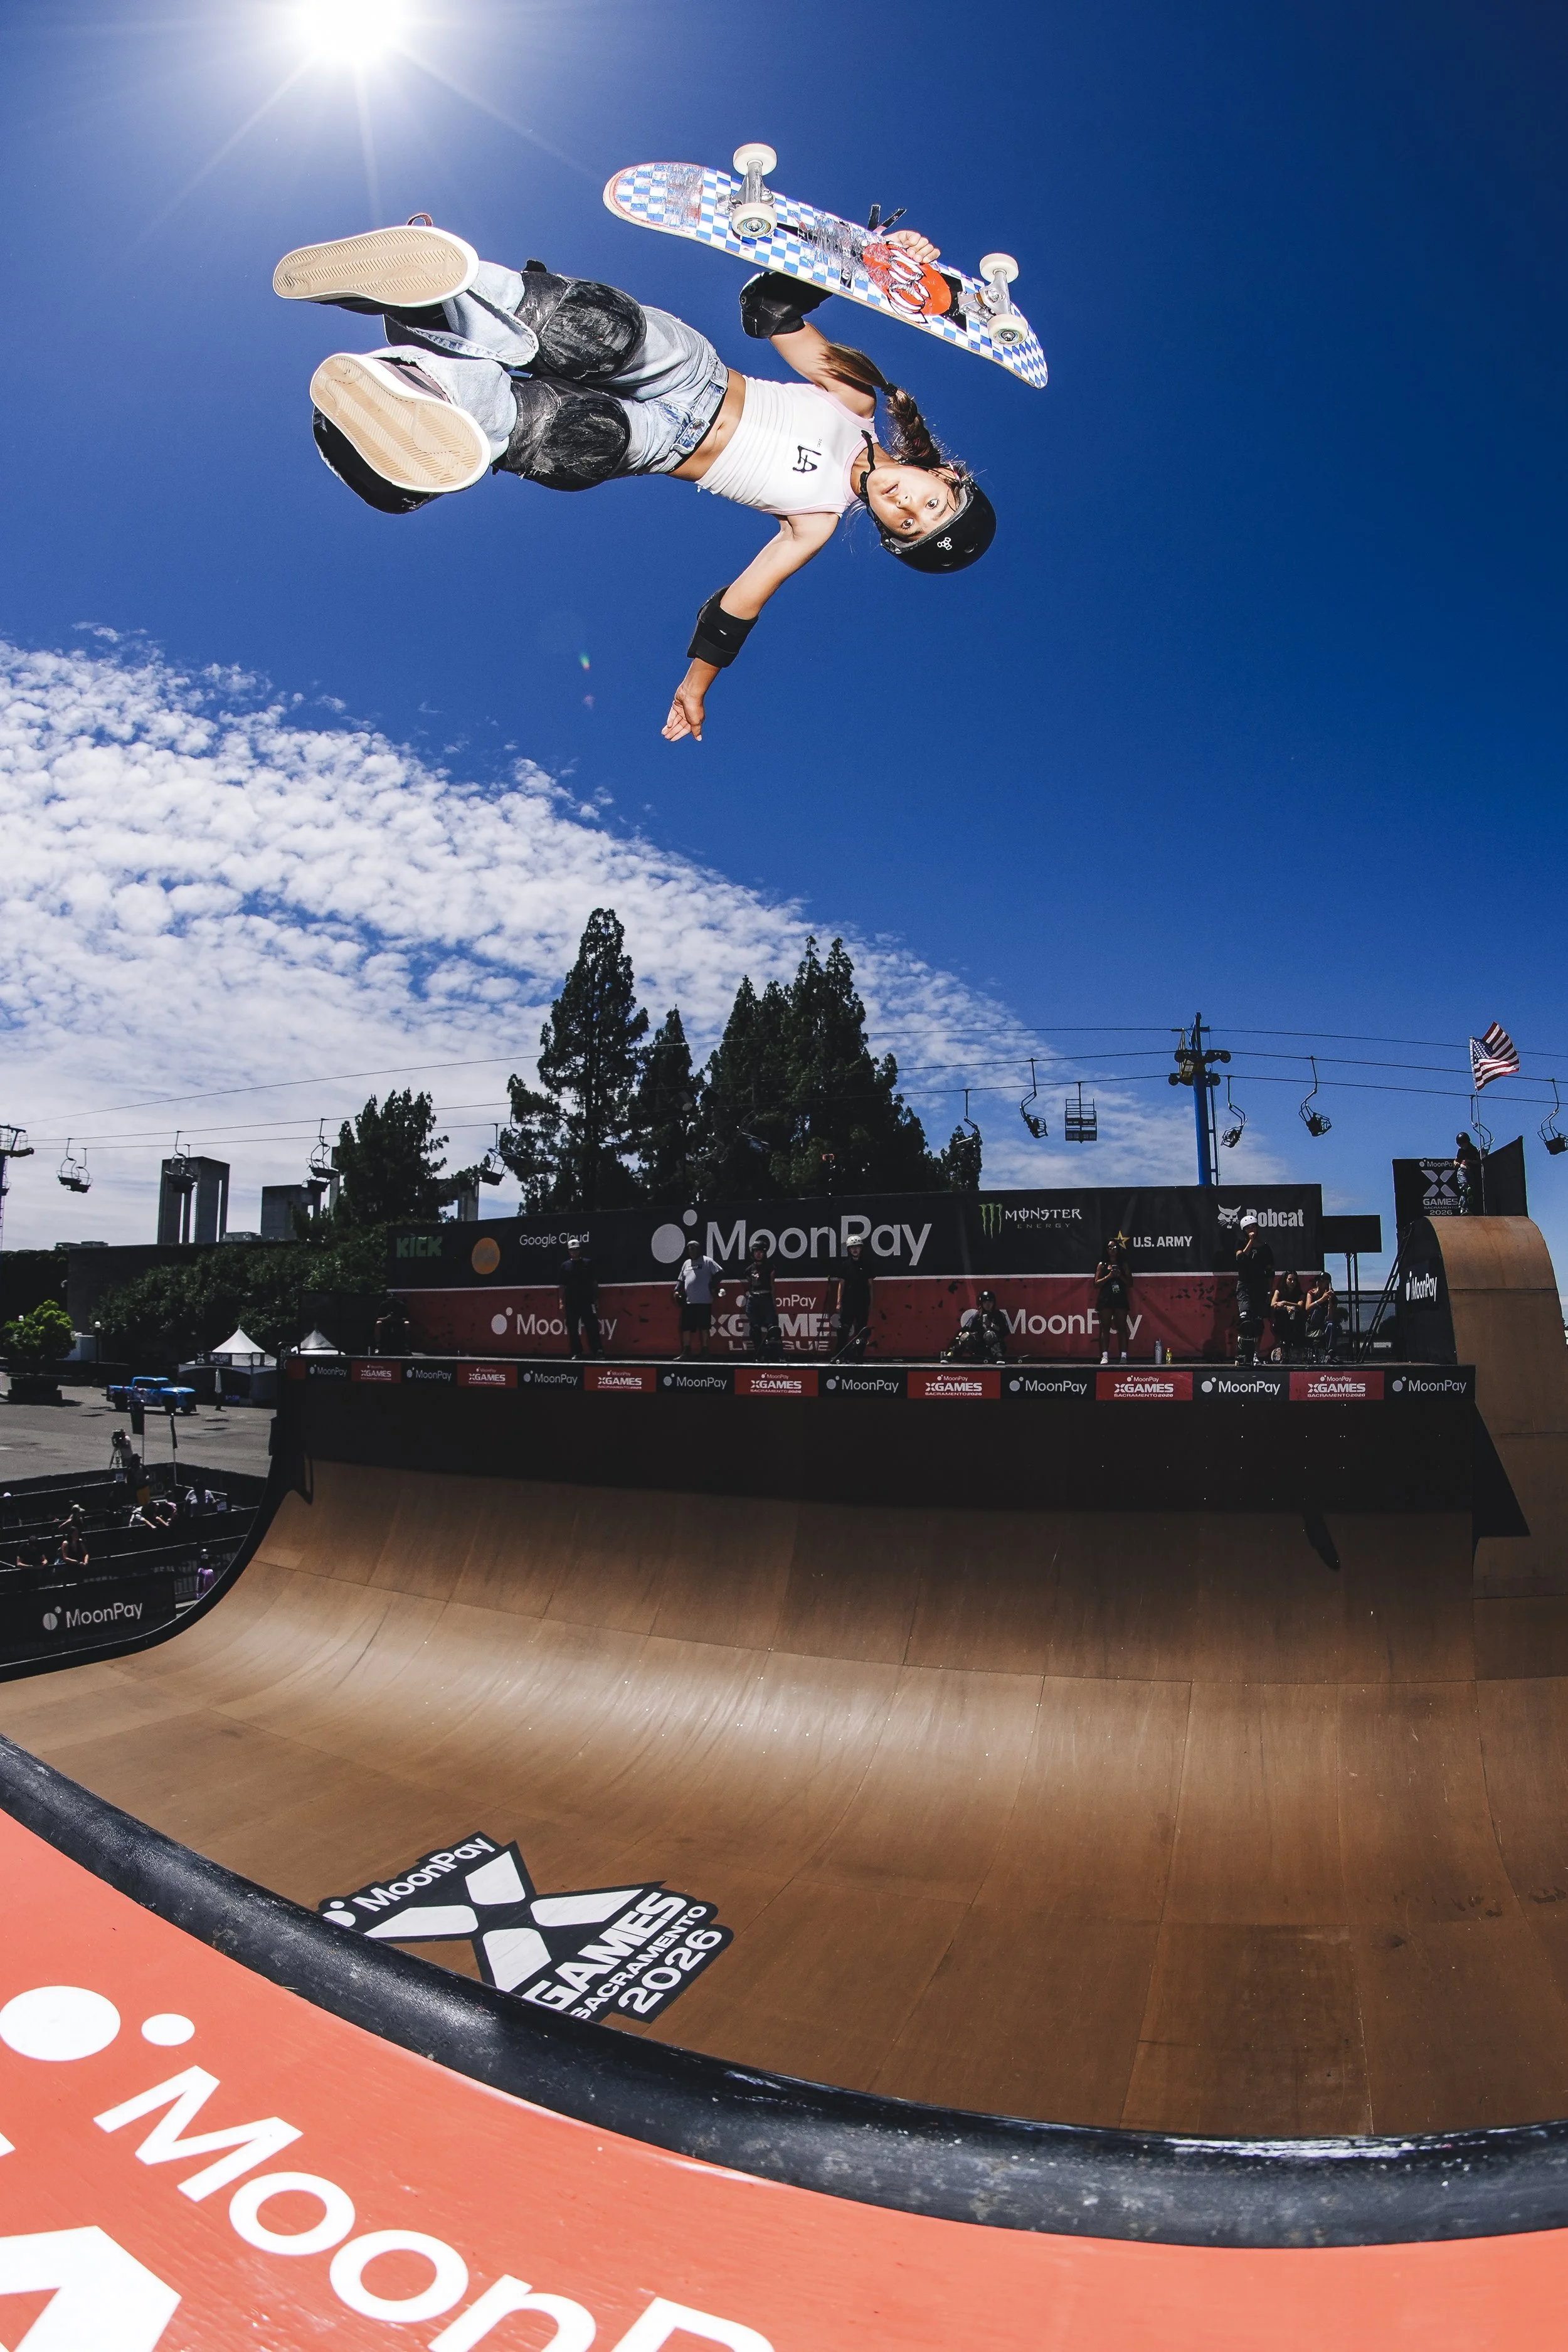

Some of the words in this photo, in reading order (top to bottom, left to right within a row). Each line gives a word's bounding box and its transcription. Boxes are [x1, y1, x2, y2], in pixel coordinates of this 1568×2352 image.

[1005, 1207, 1083, 1222] MONSTER
[396, 1236, 443, 1258] KICK
[519, 1233, 557, 1248] Google
[706, 1214, 933, 1266] MoonPay
[1133, 1236, 1155, 1248] U.S.
[1157, 1236, 1193, 1248] ARMY
[1411, 1273, 1438, 1302] MoonPay
[999, 1308, 1143, 1340] MoonPy
[728, 1340, 830, 1351] LEGUE
[317, 1367, 347, 1377] MoonPay
[415, 1370, 452, 1380] MoonPay
[534, 1373, 578, 1385] MoonPay
[676, 1376, 727, 1389] MoonPay
[842, 1379, 899, 1393] MoonPay
[1025, 1379, 1088, 1394] MoonPay
[1219, 1380, 1281, 1395] MoonPay
[1408, 1379, 1467, 1393] MoonPay
[66, 1602, 143, 1628] MoonPay
[352, 1837, 495, 1912] MoonPay
[521, 1892, 687, 2011] GAMES
[570, 1905, 707, 2020] SACRAMENTO
[618, 1929, 723, 2015] 2026
